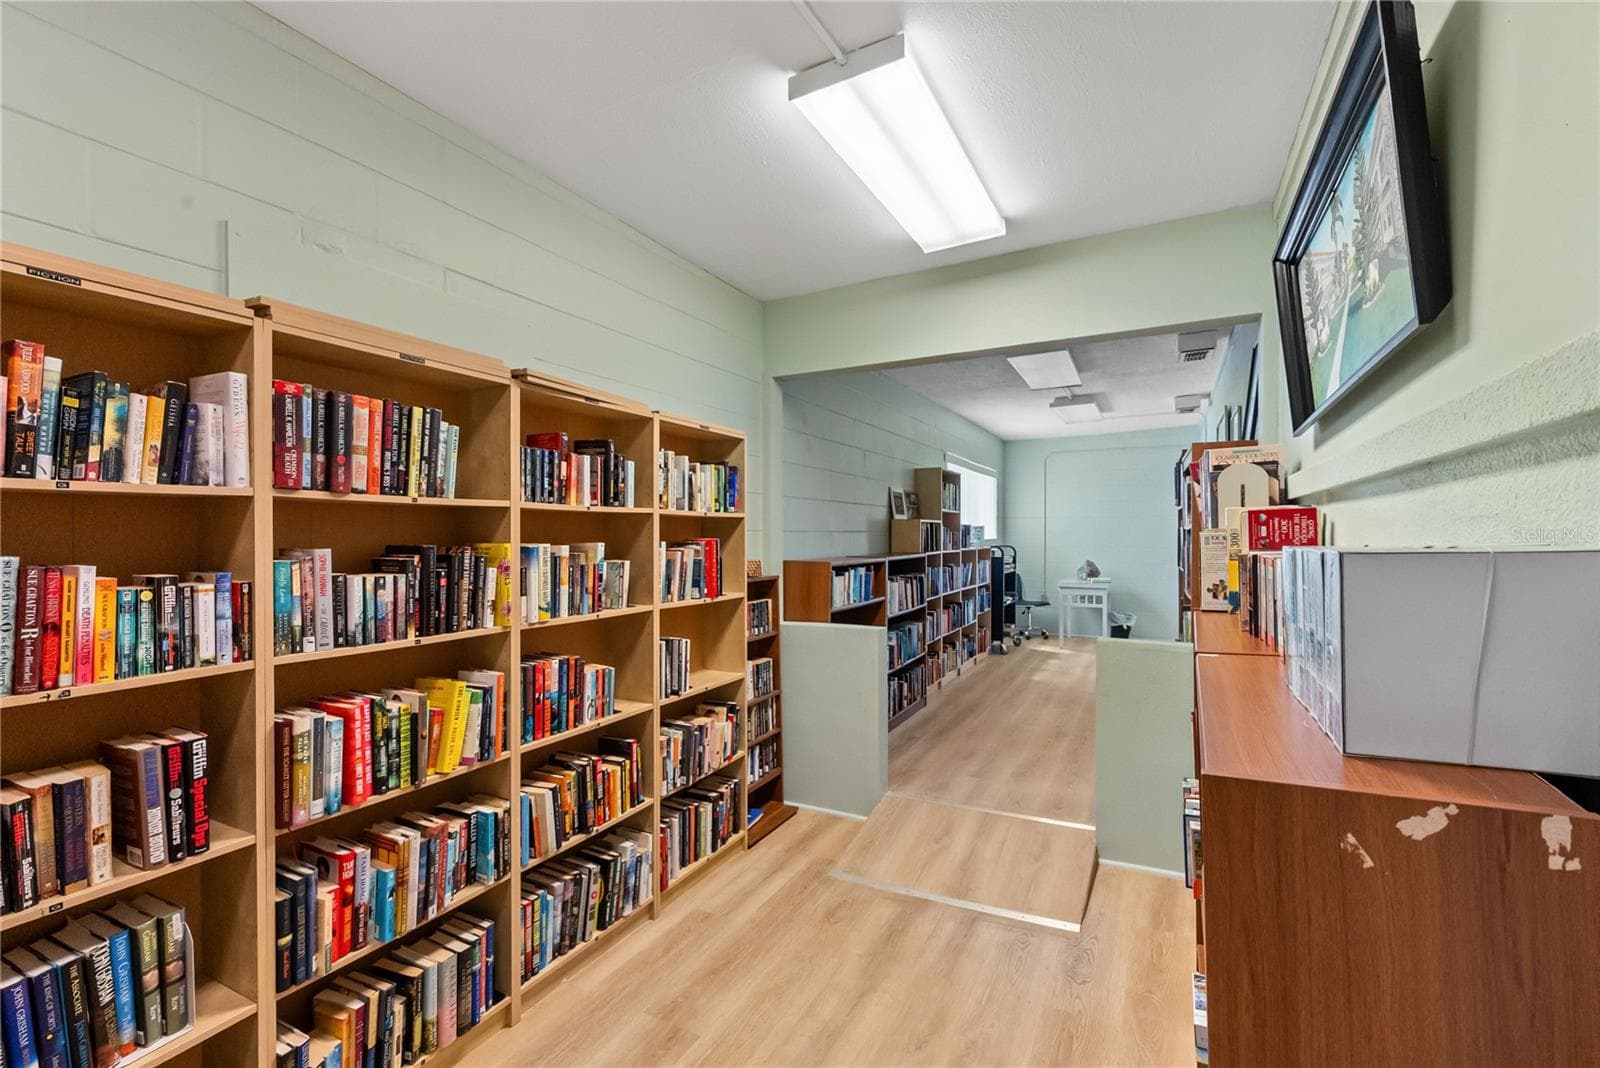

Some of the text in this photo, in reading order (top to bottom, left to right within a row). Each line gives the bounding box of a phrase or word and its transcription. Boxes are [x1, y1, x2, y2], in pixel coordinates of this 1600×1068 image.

[27, 267, 81, 285] FICTION
[40, 393, 50, 452] DAVID GATES
[168, 398, 177, 427] GEISHA
[15, 432, 25, 454] TALK
[26, 431, 35, 457] SWEET
[3, 560, 11, 575] SUE
[26, 569, 38, 585] SUE
[319, 554, 328, 597] SOPHIE HANNAH
[1, 580, 11, 621] GRAFTON
[25, 587, 37, 625] GRAFTON
[164, 586, 177, 614] Griffin
[20, 628, 39, 639] R
[81, 581, 90, 666] GOSLING DEATH PENALTIES
[1, 644, 9, 655] for
[25, 646, 33, 656] for
[24, 656, 33, 684] Ricochet
[168, 746, 181, 782] Griffin
[189, 740, 209, 847] Griffin Special Ops
[13, 812, 25, 845] Griffin
[147, 807, 164, 863] HONOR BOUND
[115, 934, 128, 960] JOHN
[142, 930, 152, 963] GRISHAM
[166, 921, 175, 953] GRISHAM
[92, 942, 111, 970] JOHN
[11, 986, 23, 1008] JOHN
[94, 966, 115, 1007] GRISHAM
[118, 960, 130, 1004] GRISHAM
[42, 974, 56, 1031] THE KING OF TORTS
[70, 965, 86, 1039] THE ASSOCIATE JOHN
[15, 1009, 29, 1048] GRISHAM
